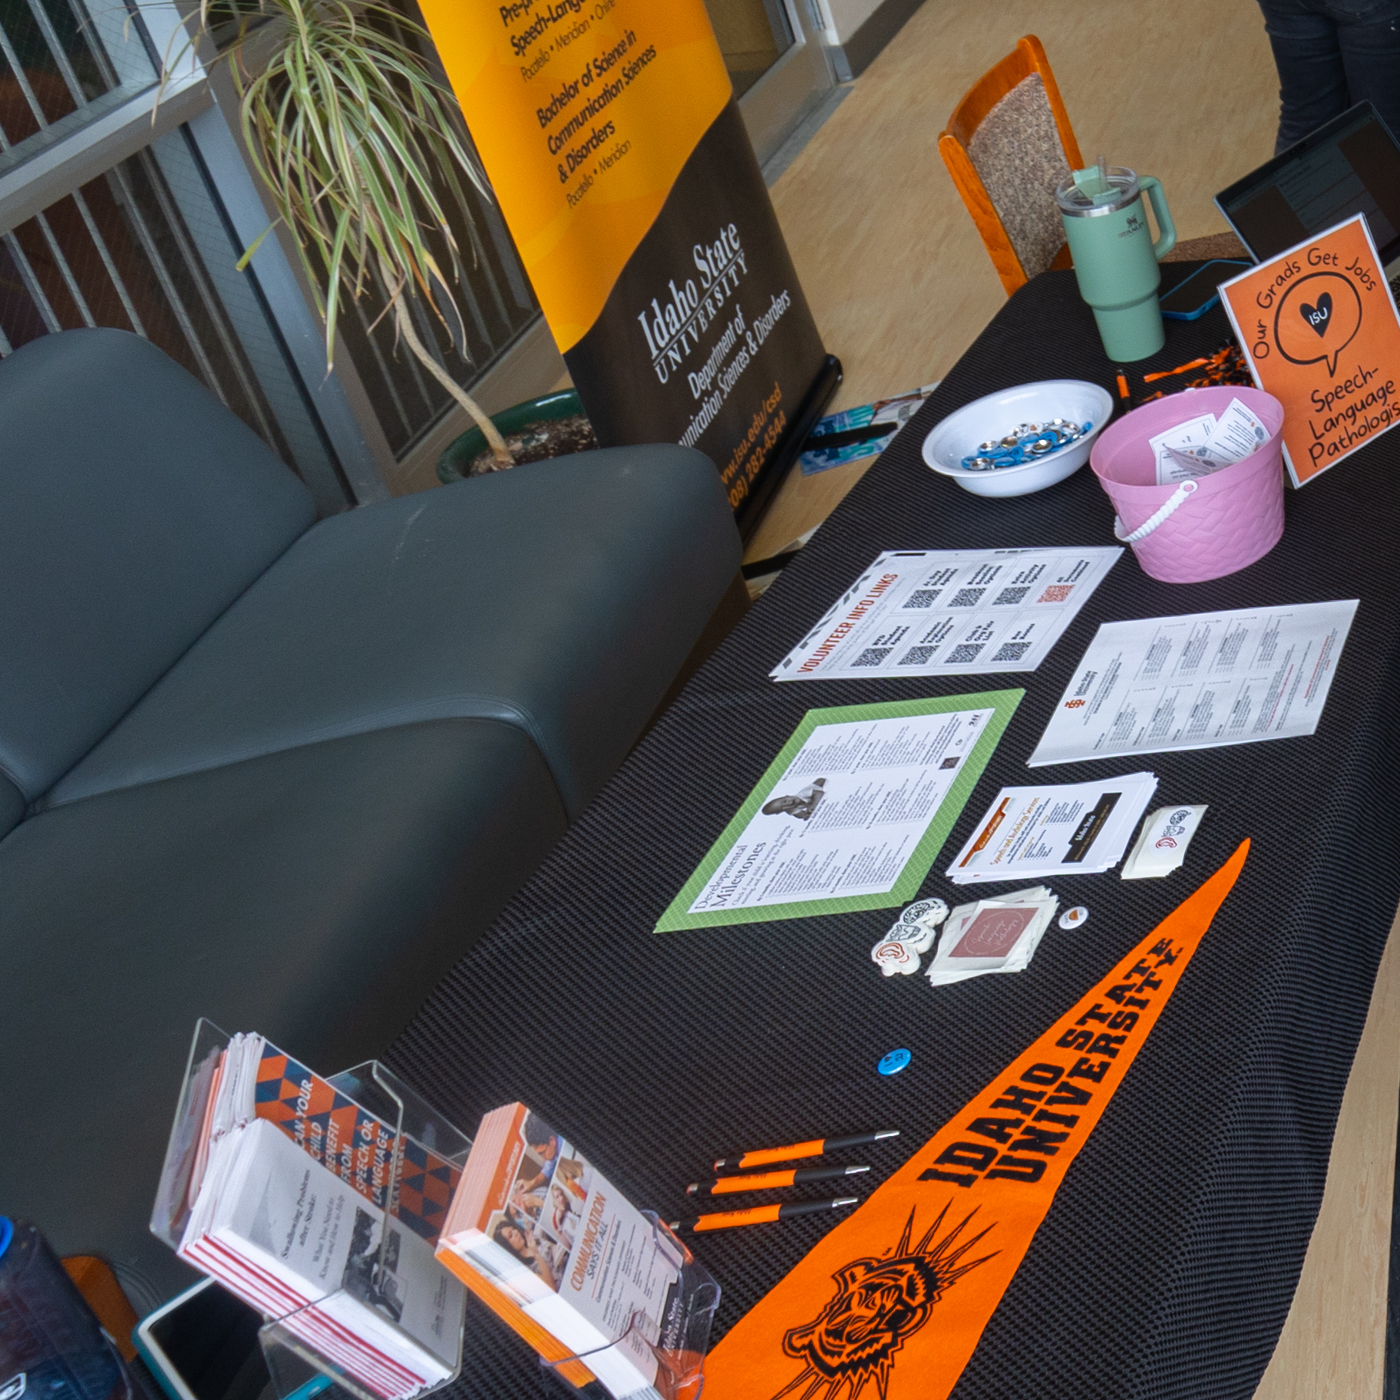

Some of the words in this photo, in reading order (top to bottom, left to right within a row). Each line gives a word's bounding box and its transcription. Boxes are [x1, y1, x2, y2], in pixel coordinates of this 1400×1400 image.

[520, 48, 550, 82] Pocatello
[554, 18, 590, 53] Meridian
[536, 78, 580, 129] Bachelor
[581, 64, 593, 88] of
[593, 40, 626, 76] Science
[625, 29, 637, 48] in
[547, 77, 623, 156] Communication
[622, 44, 657, 85] Sciences
[558, 166, 568, 184] &
[566, 120, 616, 172] Disorders
[566, 172, 594, 209] Pocatello
[598, 139, 632, 175] Meridian
[1308, 248, 1339, 267] Get
[1345, 256, 1376, 291] Jobs
[638, 280, 699, 361] Idaho
[693, 222, 741, 289] State
[1256, 260, 1301, 309] Grads
[654, 252, 749, 384] UNIVERSITY
[1253, 319, 1270, 359] Our
[1309, 307, 1328, 326] ISU
[688, 330, 736, 399] Department
[736, 304, 746, 334] of
[718, 350, 750, 399] Sciences
[746, 332, 759, 356] &
[754, 290, 791, 346] Disorders
[1309, 380, 1395, 440] Language
[1311, 365, 1379, 413] Speech-
[797, 622, 855, 674] VOLUNTEER
[846, 600, 875, 621] INFO
[869, 573, 899, 598] LINKS
[694, 844, 749, 910] Developmental
[714, 841, 767, 908] Milestones
[916, 1063, 1066, 1189] IDAHO
[1055, 937, 1172, 1048] STATE
[984, 947, 1184, 1184] UNIVERSITY
[295, 1078, 313, 1118] YOUR
[307, 1121, 325, 1160] CHILD
[320, 1118, 342, 1172] BENEFIT
[359, 1118, 376, 1141] OR
[338, 1144, 356, 1183] FROM
[353, 1143, 373, 1193] SPEECH
[368, 1130, 392, 1204] LANGUAGE
[280, 1205, 302, 1259] Swallowing
[291, 1167, 313, 1208] Problems
[318, 1204, 335, 1227] Need
[332, 1193, 348, 1214] Help
[294, 1222, 310, 1246] after
[307, 1239, 324, 1262] What
[313, 1223, 329, 1243] You
[320, 1242, 333, 1259] and
[323, 1220, 341, 1244] How
[567, 1192, 609, 1292] COMMUNICATION
[592, 1238, 603, 1252] IT
[595, 1220, 609, 1240] ALL
[312, 1256, 330, 1279] Know
[585, 1253, 600, 1279] SAYS
